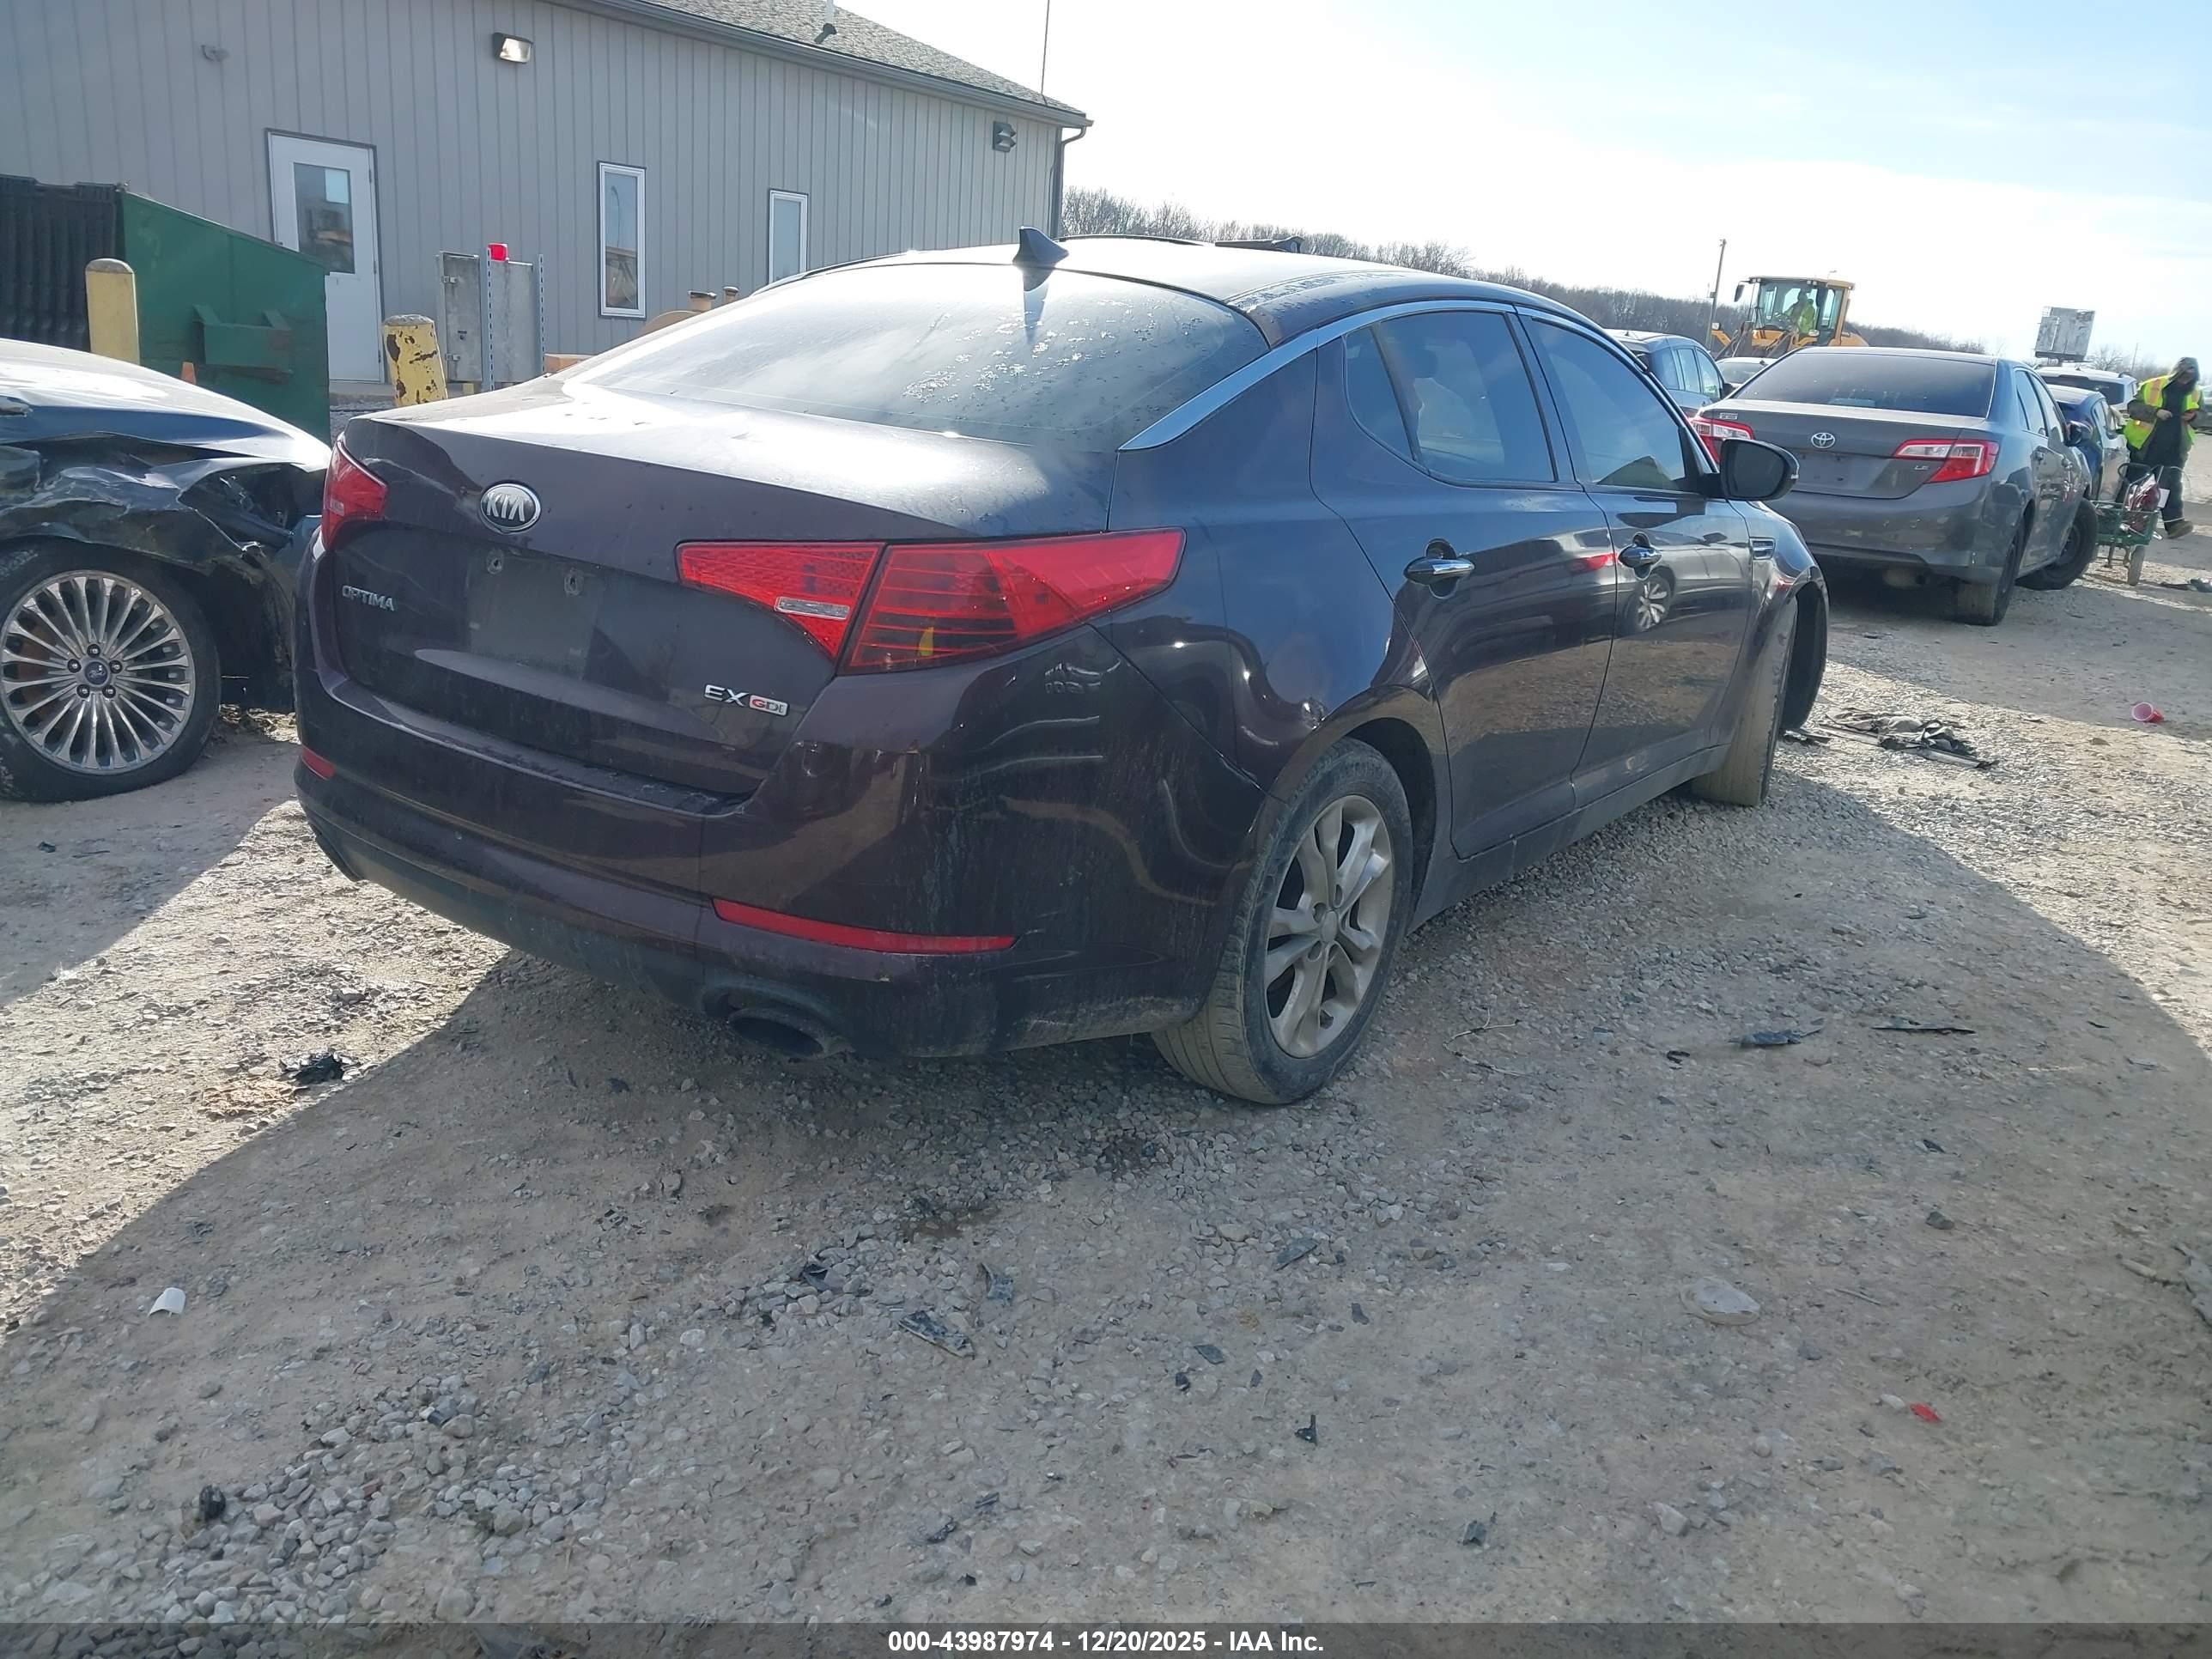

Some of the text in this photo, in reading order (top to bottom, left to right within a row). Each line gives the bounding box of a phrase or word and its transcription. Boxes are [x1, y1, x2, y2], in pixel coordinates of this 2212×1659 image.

[486, 492, 526, 522] KIA
[342, 585, 395, 611] OPTIMA
[704, 684, 784, 714] EX GDI
